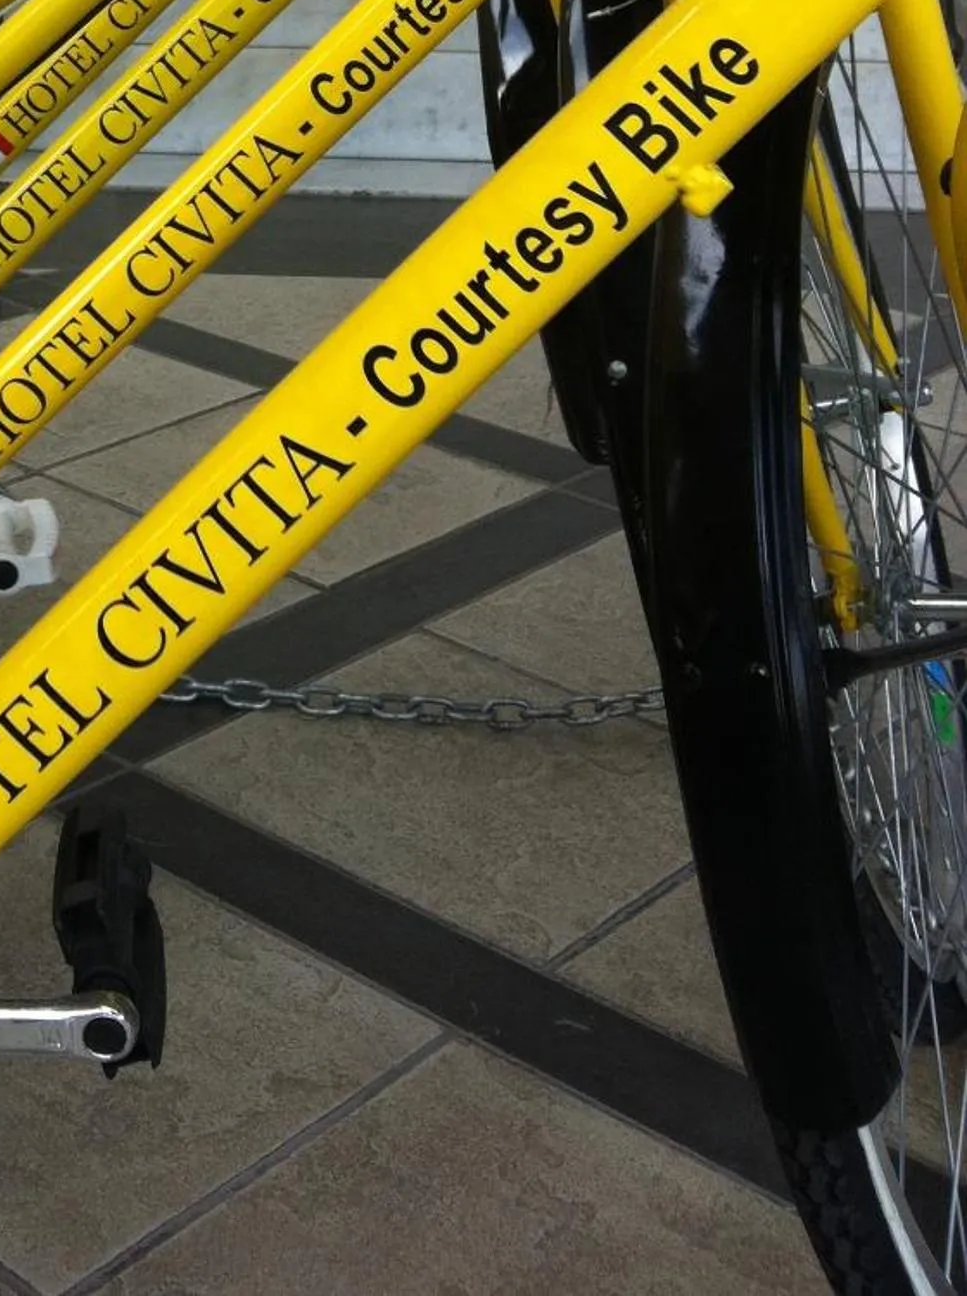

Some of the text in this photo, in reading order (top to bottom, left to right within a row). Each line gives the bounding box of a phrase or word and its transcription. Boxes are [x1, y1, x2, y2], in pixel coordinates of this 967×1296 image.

[0, 31, 113, 138] HOTEL
[98, 16, 237, 145] CIVITA
[126, 134, 305, 297] CIVITA
[97, 434, 356, 669] CIVITA
[362, 161, 629, 408] Courtesy
[603, 37, 760, 174] Bike
